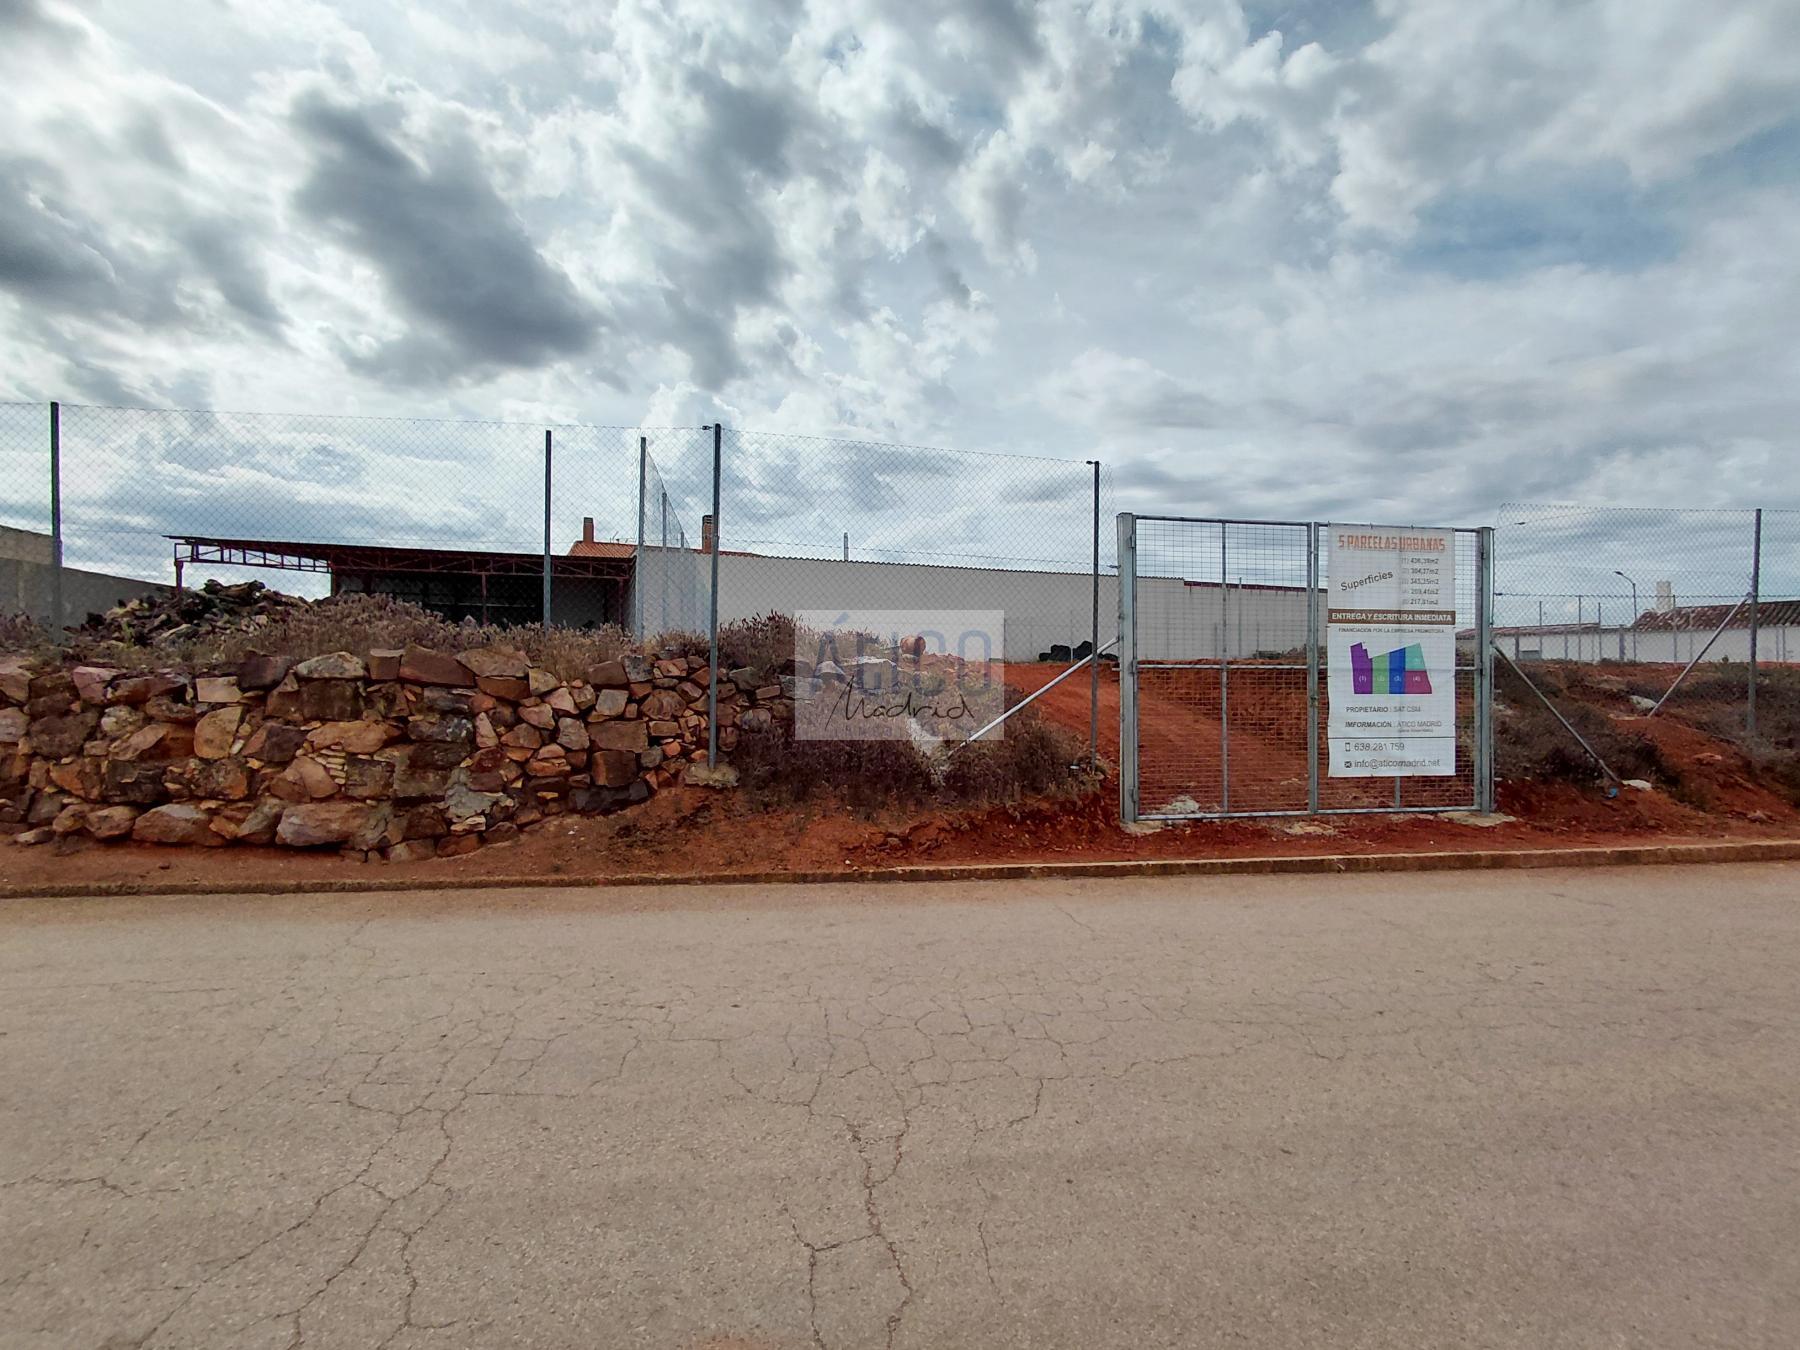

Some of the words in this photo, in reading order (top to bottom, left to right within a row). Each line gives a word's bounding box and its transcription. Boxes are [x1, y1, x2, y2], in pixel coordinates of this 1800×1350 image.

[1338, 534, 1345, 550] 5
[1347, 535, 1397, 550] PARCELAS
[1399, 536, 1446, 552] URBANAS
[1340, 571, 1394, 591] Superficies
[1332, 612, 1366, 620] ENTREGA
[1374, 613, 1413, 621] ESCRITURA
[1414, 614, 1452, 622] INMEDIATA
[1354, 759, 1441, 770] info@aticomadrid.net
